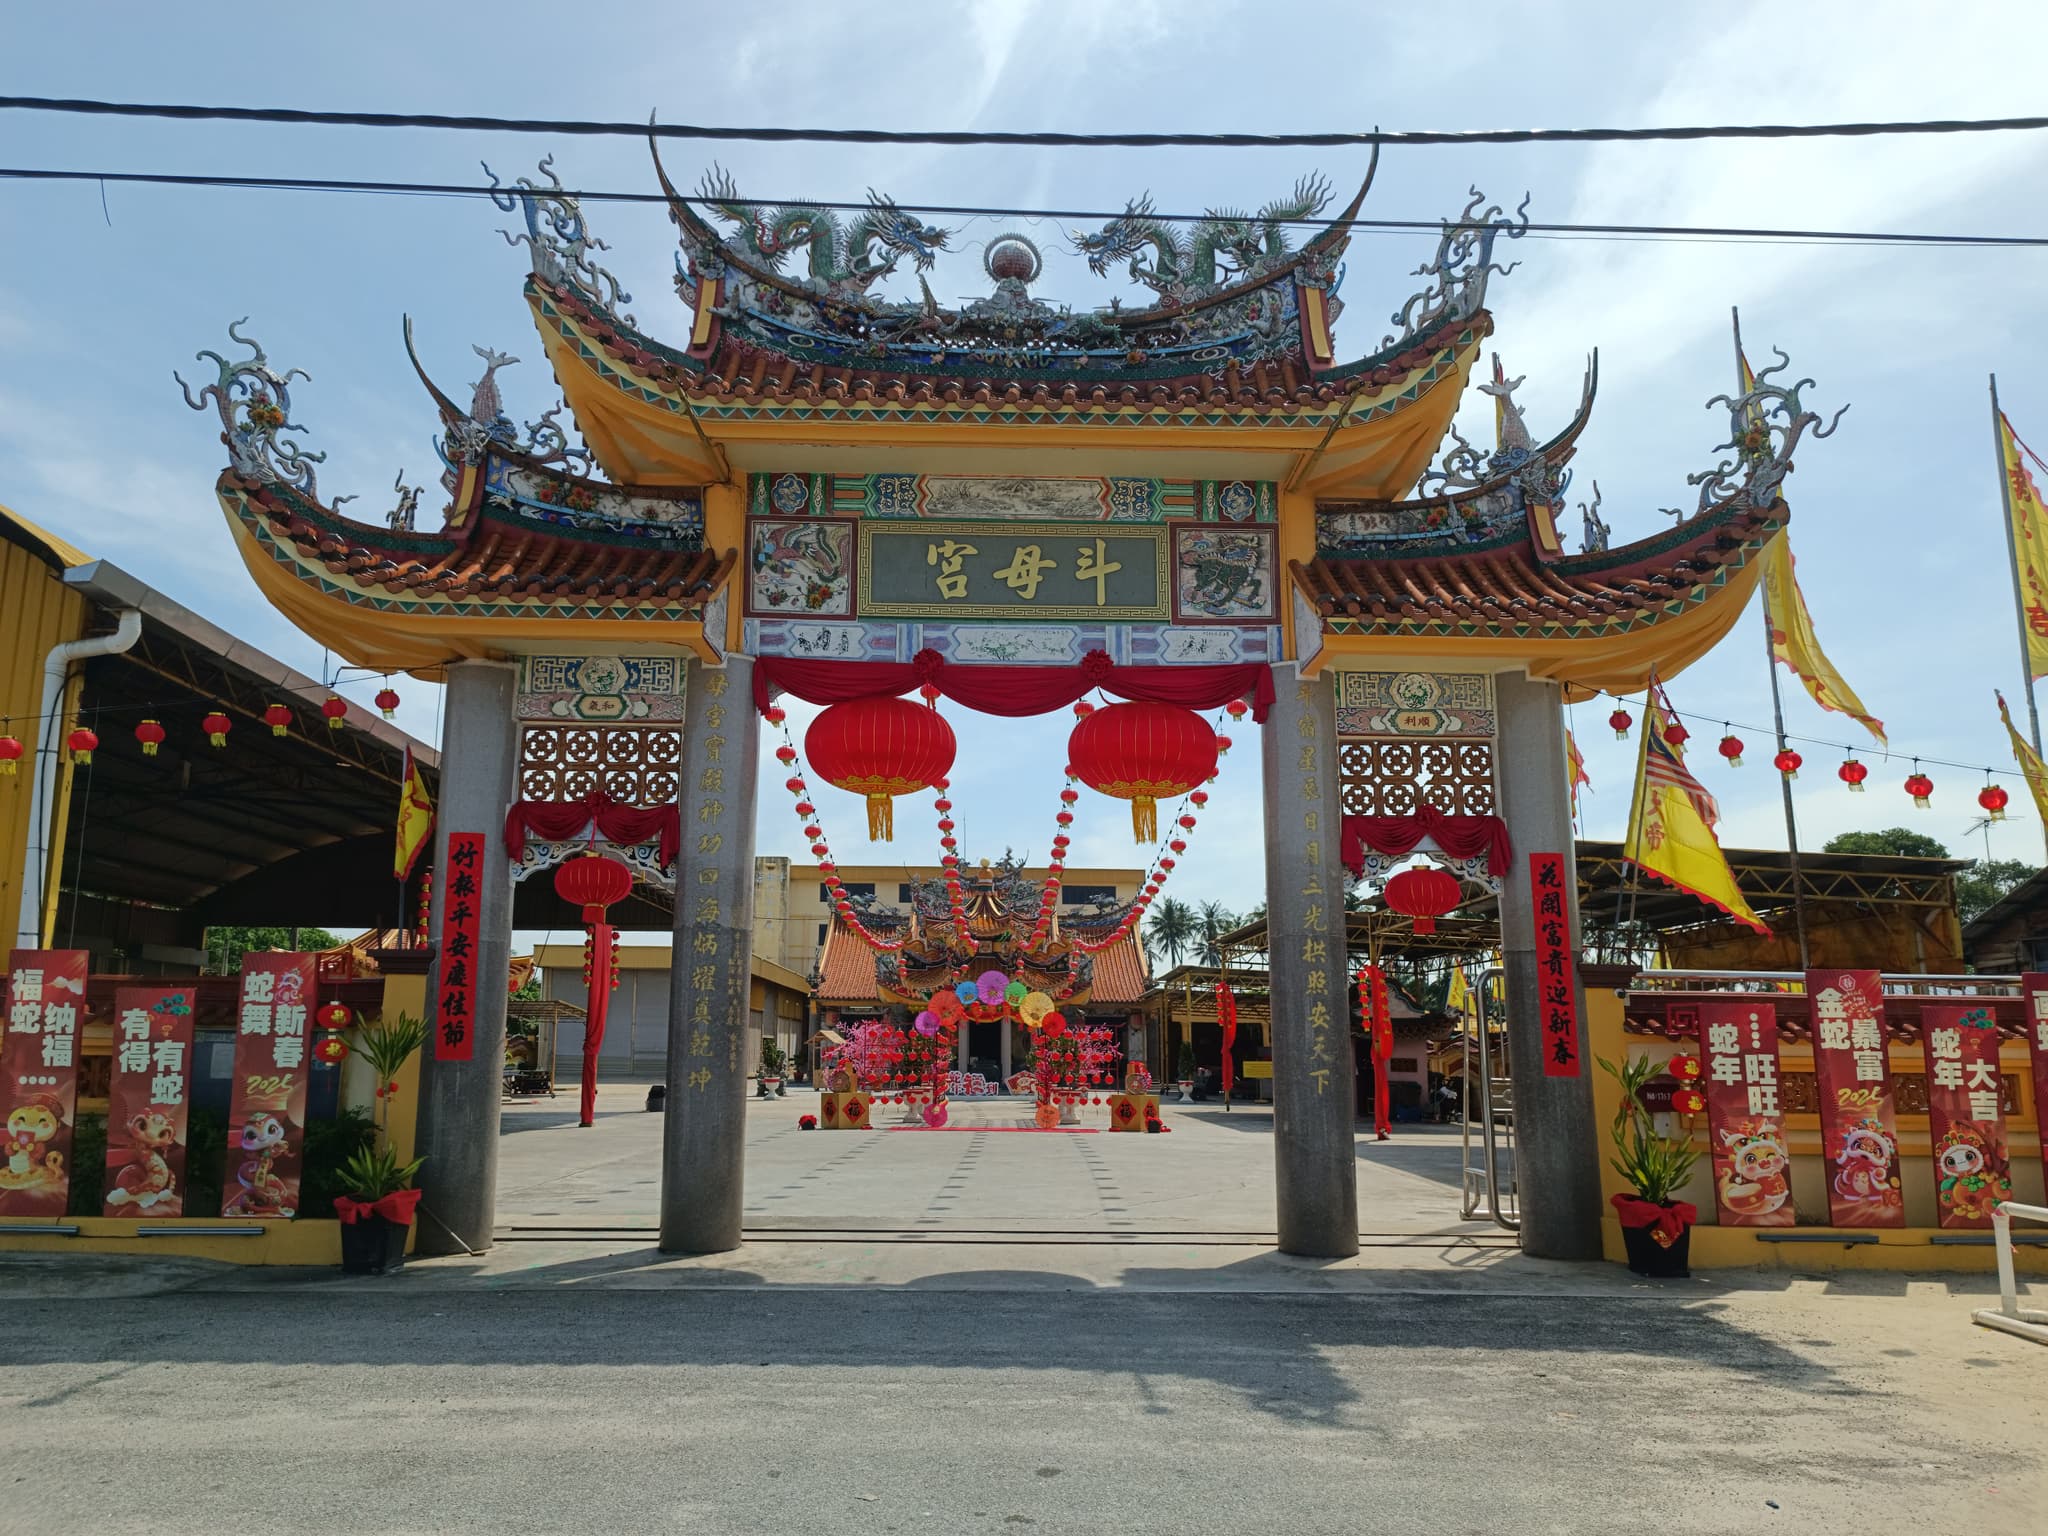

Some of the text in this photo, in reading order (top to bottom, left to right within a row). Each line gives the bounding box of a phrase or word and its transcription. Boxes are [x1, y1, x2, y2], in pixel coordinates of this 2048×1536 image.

[1538, 863, 1575, 1065] 花開富貴迎新春
[246, 1073, 294, 1095] 2025
[1837, 1085, 1884, 1106] 2025
